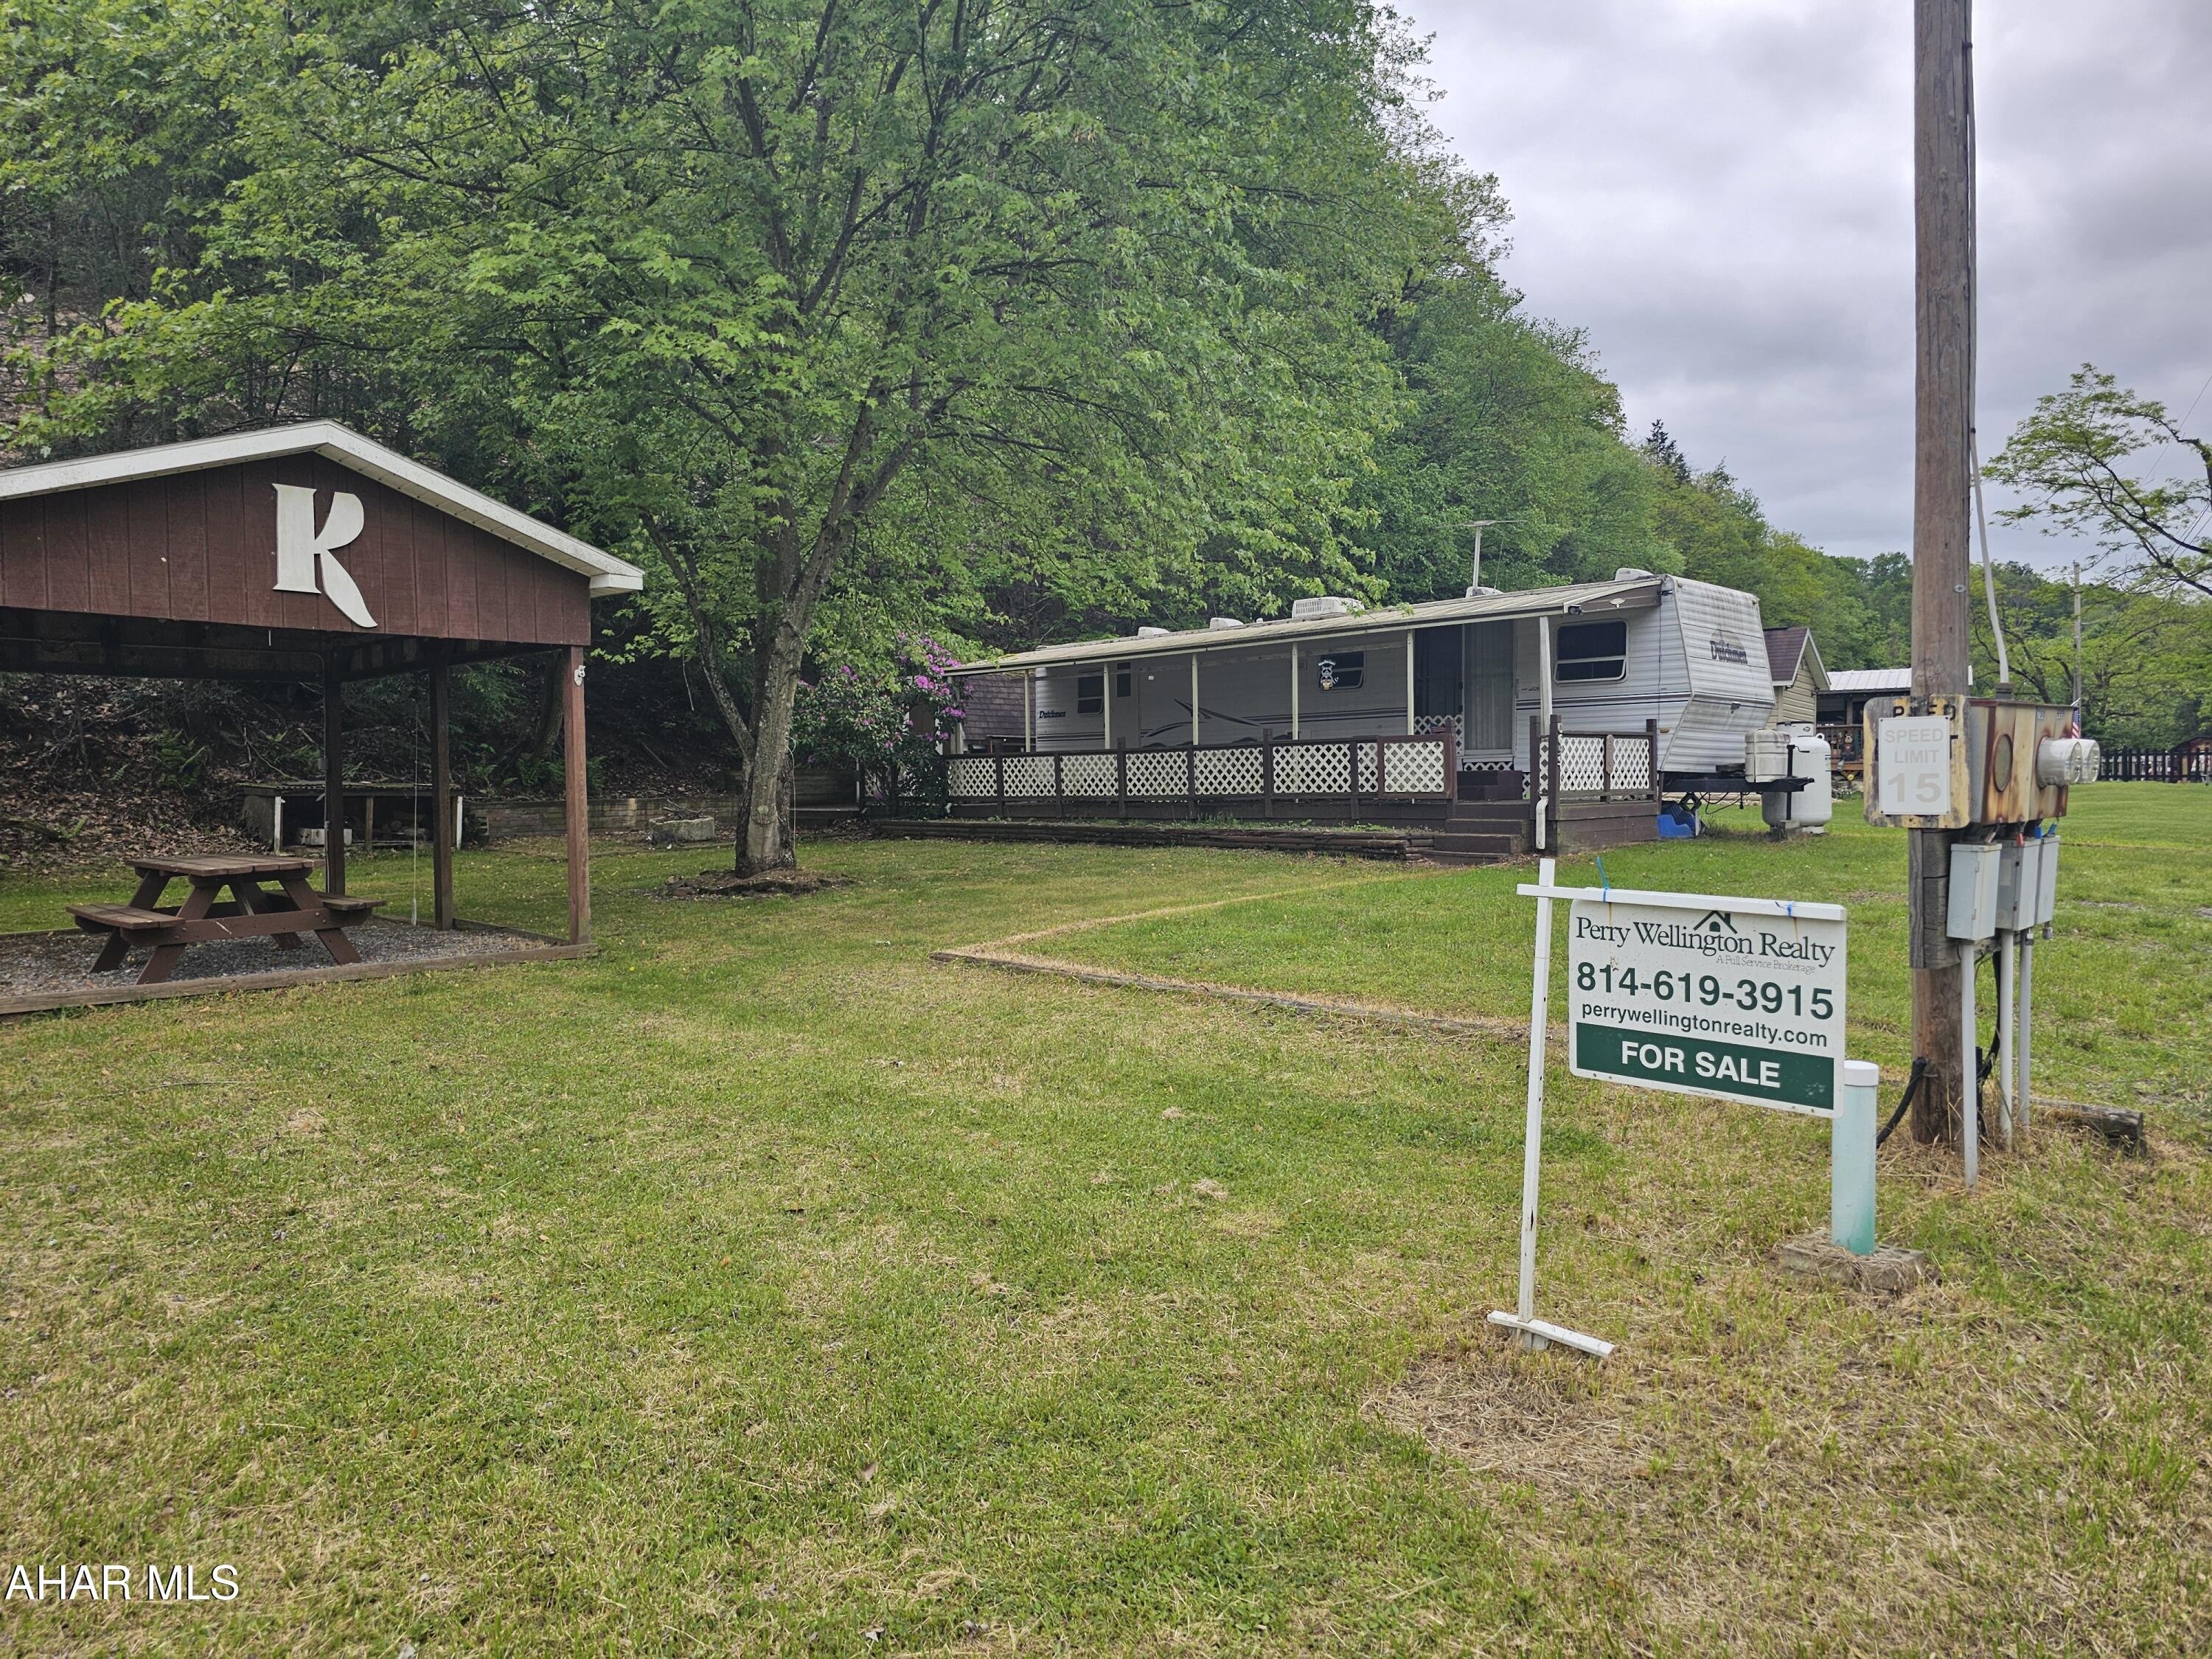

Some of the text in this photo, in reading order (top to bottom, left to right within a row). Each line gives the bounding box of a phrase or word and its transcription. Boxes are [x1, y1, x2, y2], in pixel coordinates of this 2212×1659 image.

[1710, 640, 1748, 664] Dutchmen
[1884, 728, 1944, 743] SPEED
[1894, 749, 1940, 764] LIMIT
[1888, 773, 1941, 803] 15
[1576, 917, 1835, 967] Perry Wellington Realty
[1716, 955, 1816, 975] A Full Service Brokerage
[1576, 961, 1834, 1020] 814-619-3915
[1582, 1002, 1827, 1047] perrywellingtonrealty.com
[1621, 1040, 1781, 1088] FOR SALE
